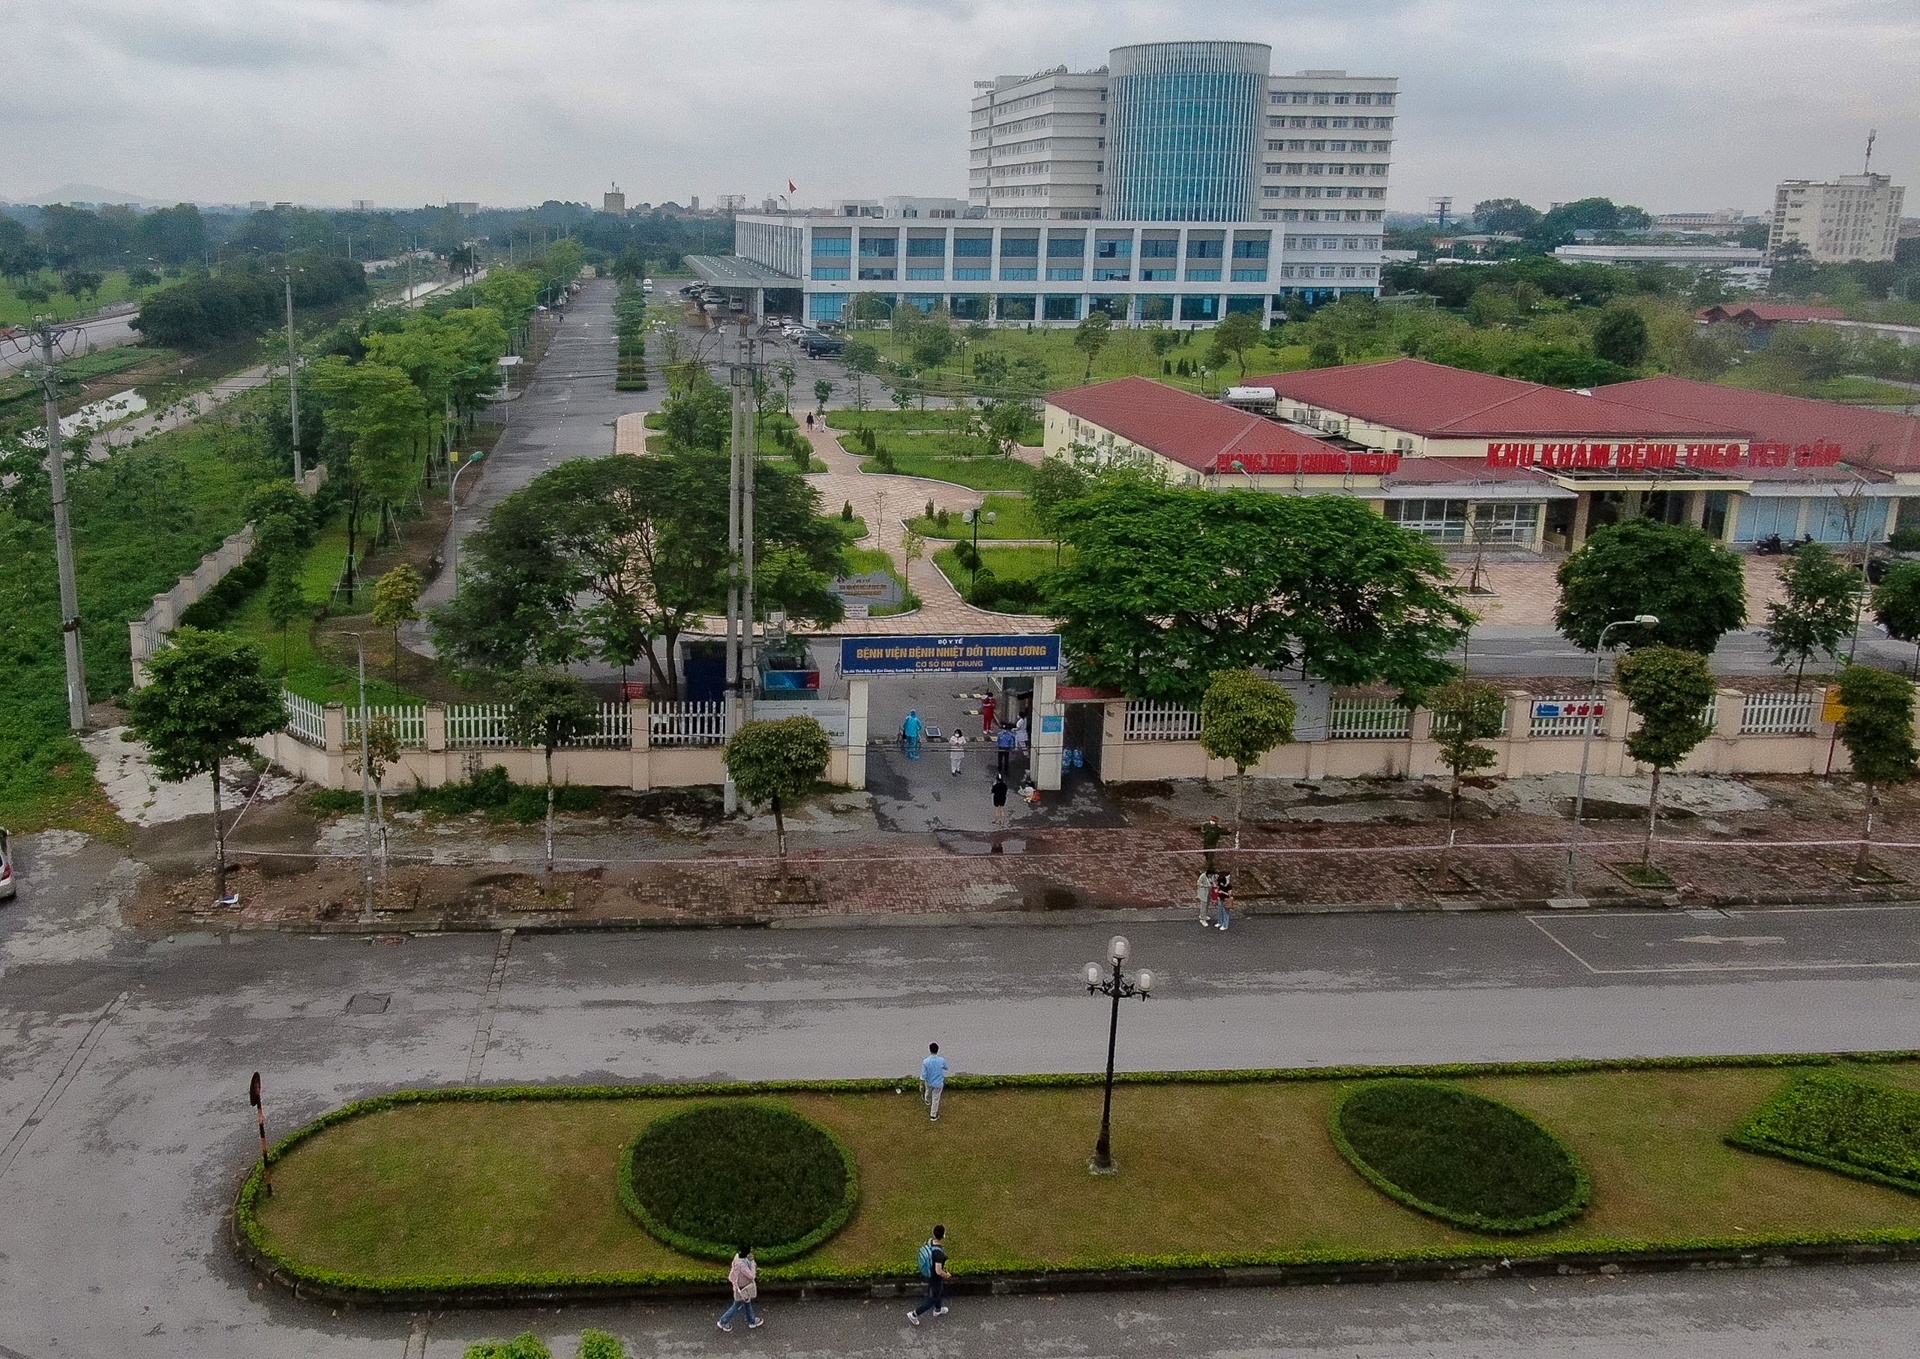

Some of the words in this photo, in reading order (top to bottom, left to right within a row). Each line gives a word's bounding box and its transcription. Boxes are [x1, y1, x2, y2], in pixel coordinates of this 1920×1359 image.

[1487, 443, 1536, 467] KHU
[1541, 437, 1611, 467] KHÁM
[1617, 437, 1677, 472] BỆNH
[1686, 443, 1741, 467] THEO
[856, 647, 884, 660] BỆNH
[885, 646, 907, 659] VIỆN
[908, 646, 935, 659] BỆNH
[936, 646, 965, 658] NHIỆT
[966, 644, 983, 657] ĐỚI
[985, 646, 1018, 656] TRUNG
[1019, 645, 1047, 656] ƯƠNG
